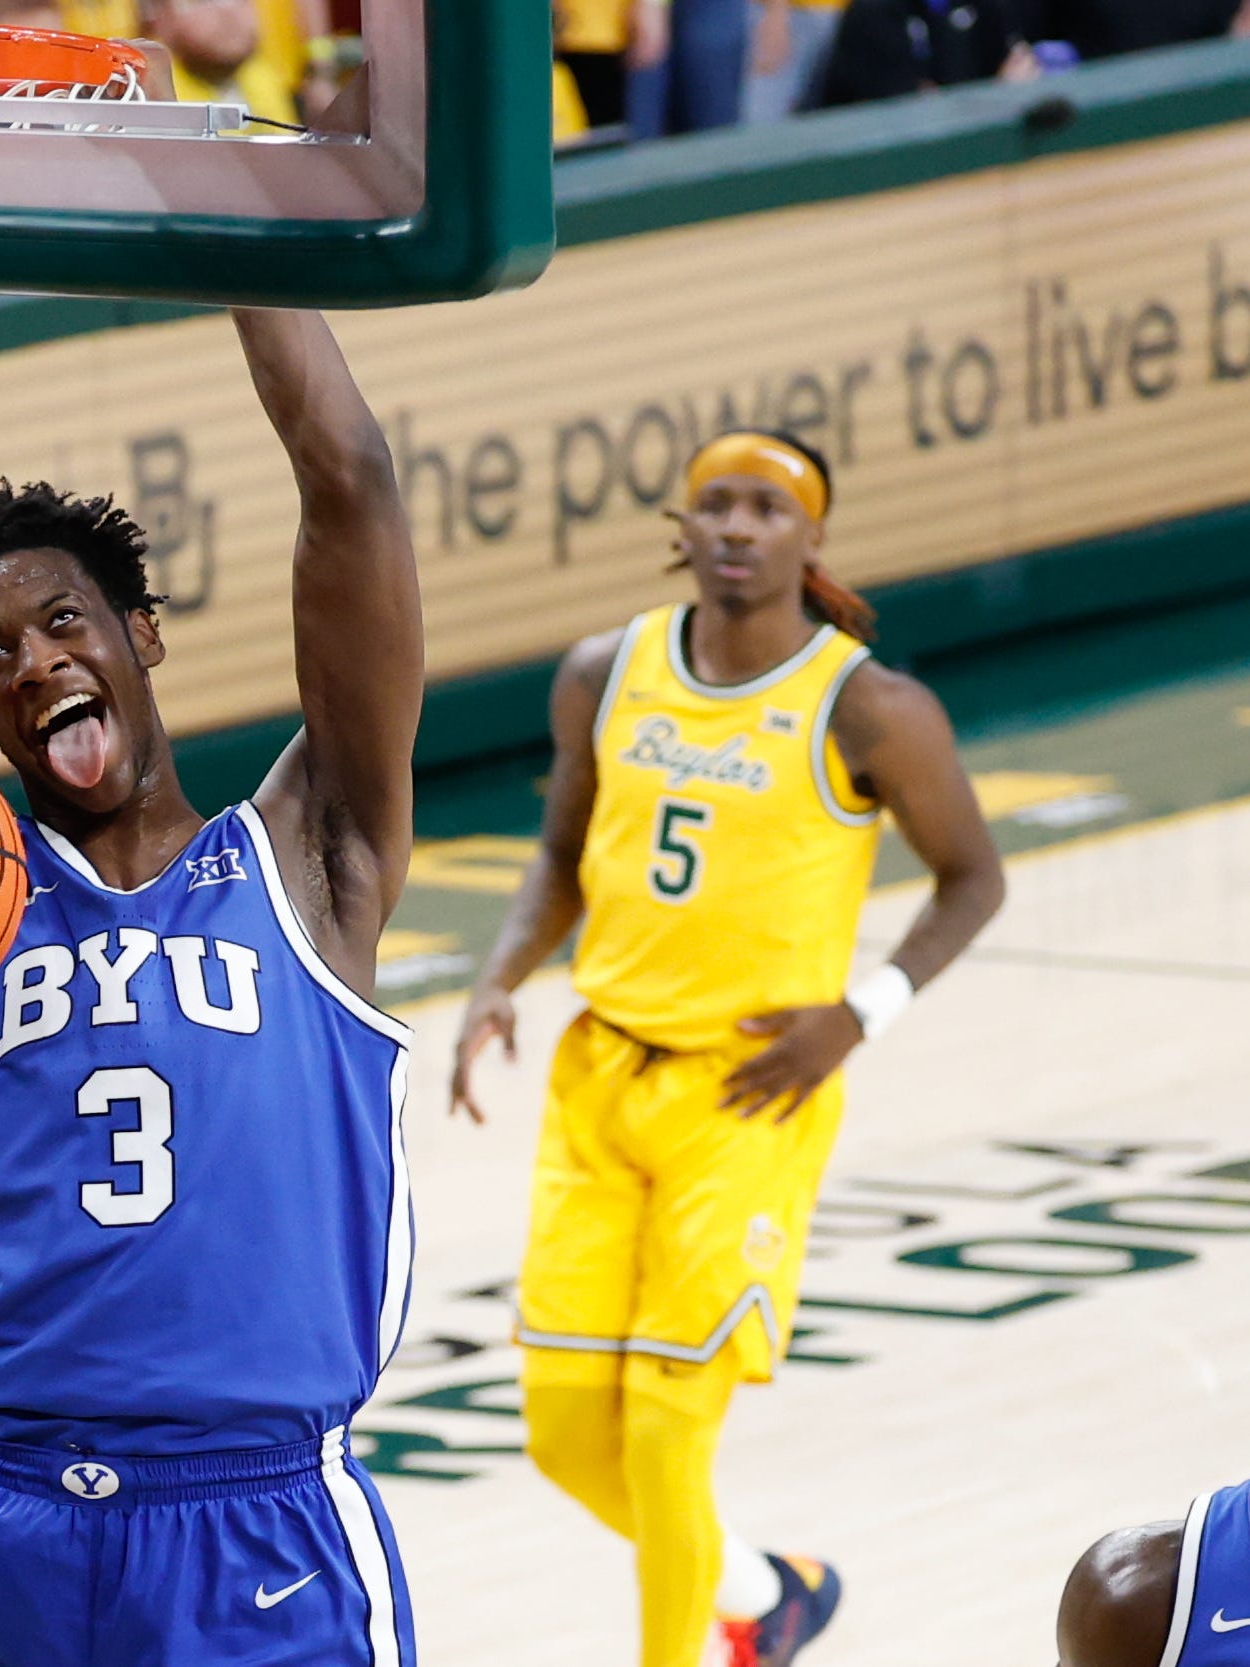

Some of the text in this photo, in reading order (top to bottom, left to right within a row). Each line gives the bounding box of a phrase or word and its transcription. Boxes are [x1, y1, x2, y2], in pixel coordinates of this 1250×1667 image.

[384, 408, 523, 547] he
[904, 327, 999, 449] to
[1025, 276, 1180, 426] live
[652, 800, 707, 898] 5
[76, 1065, 175, 1228] 3
[70, 1466, 109, 1496] Y
